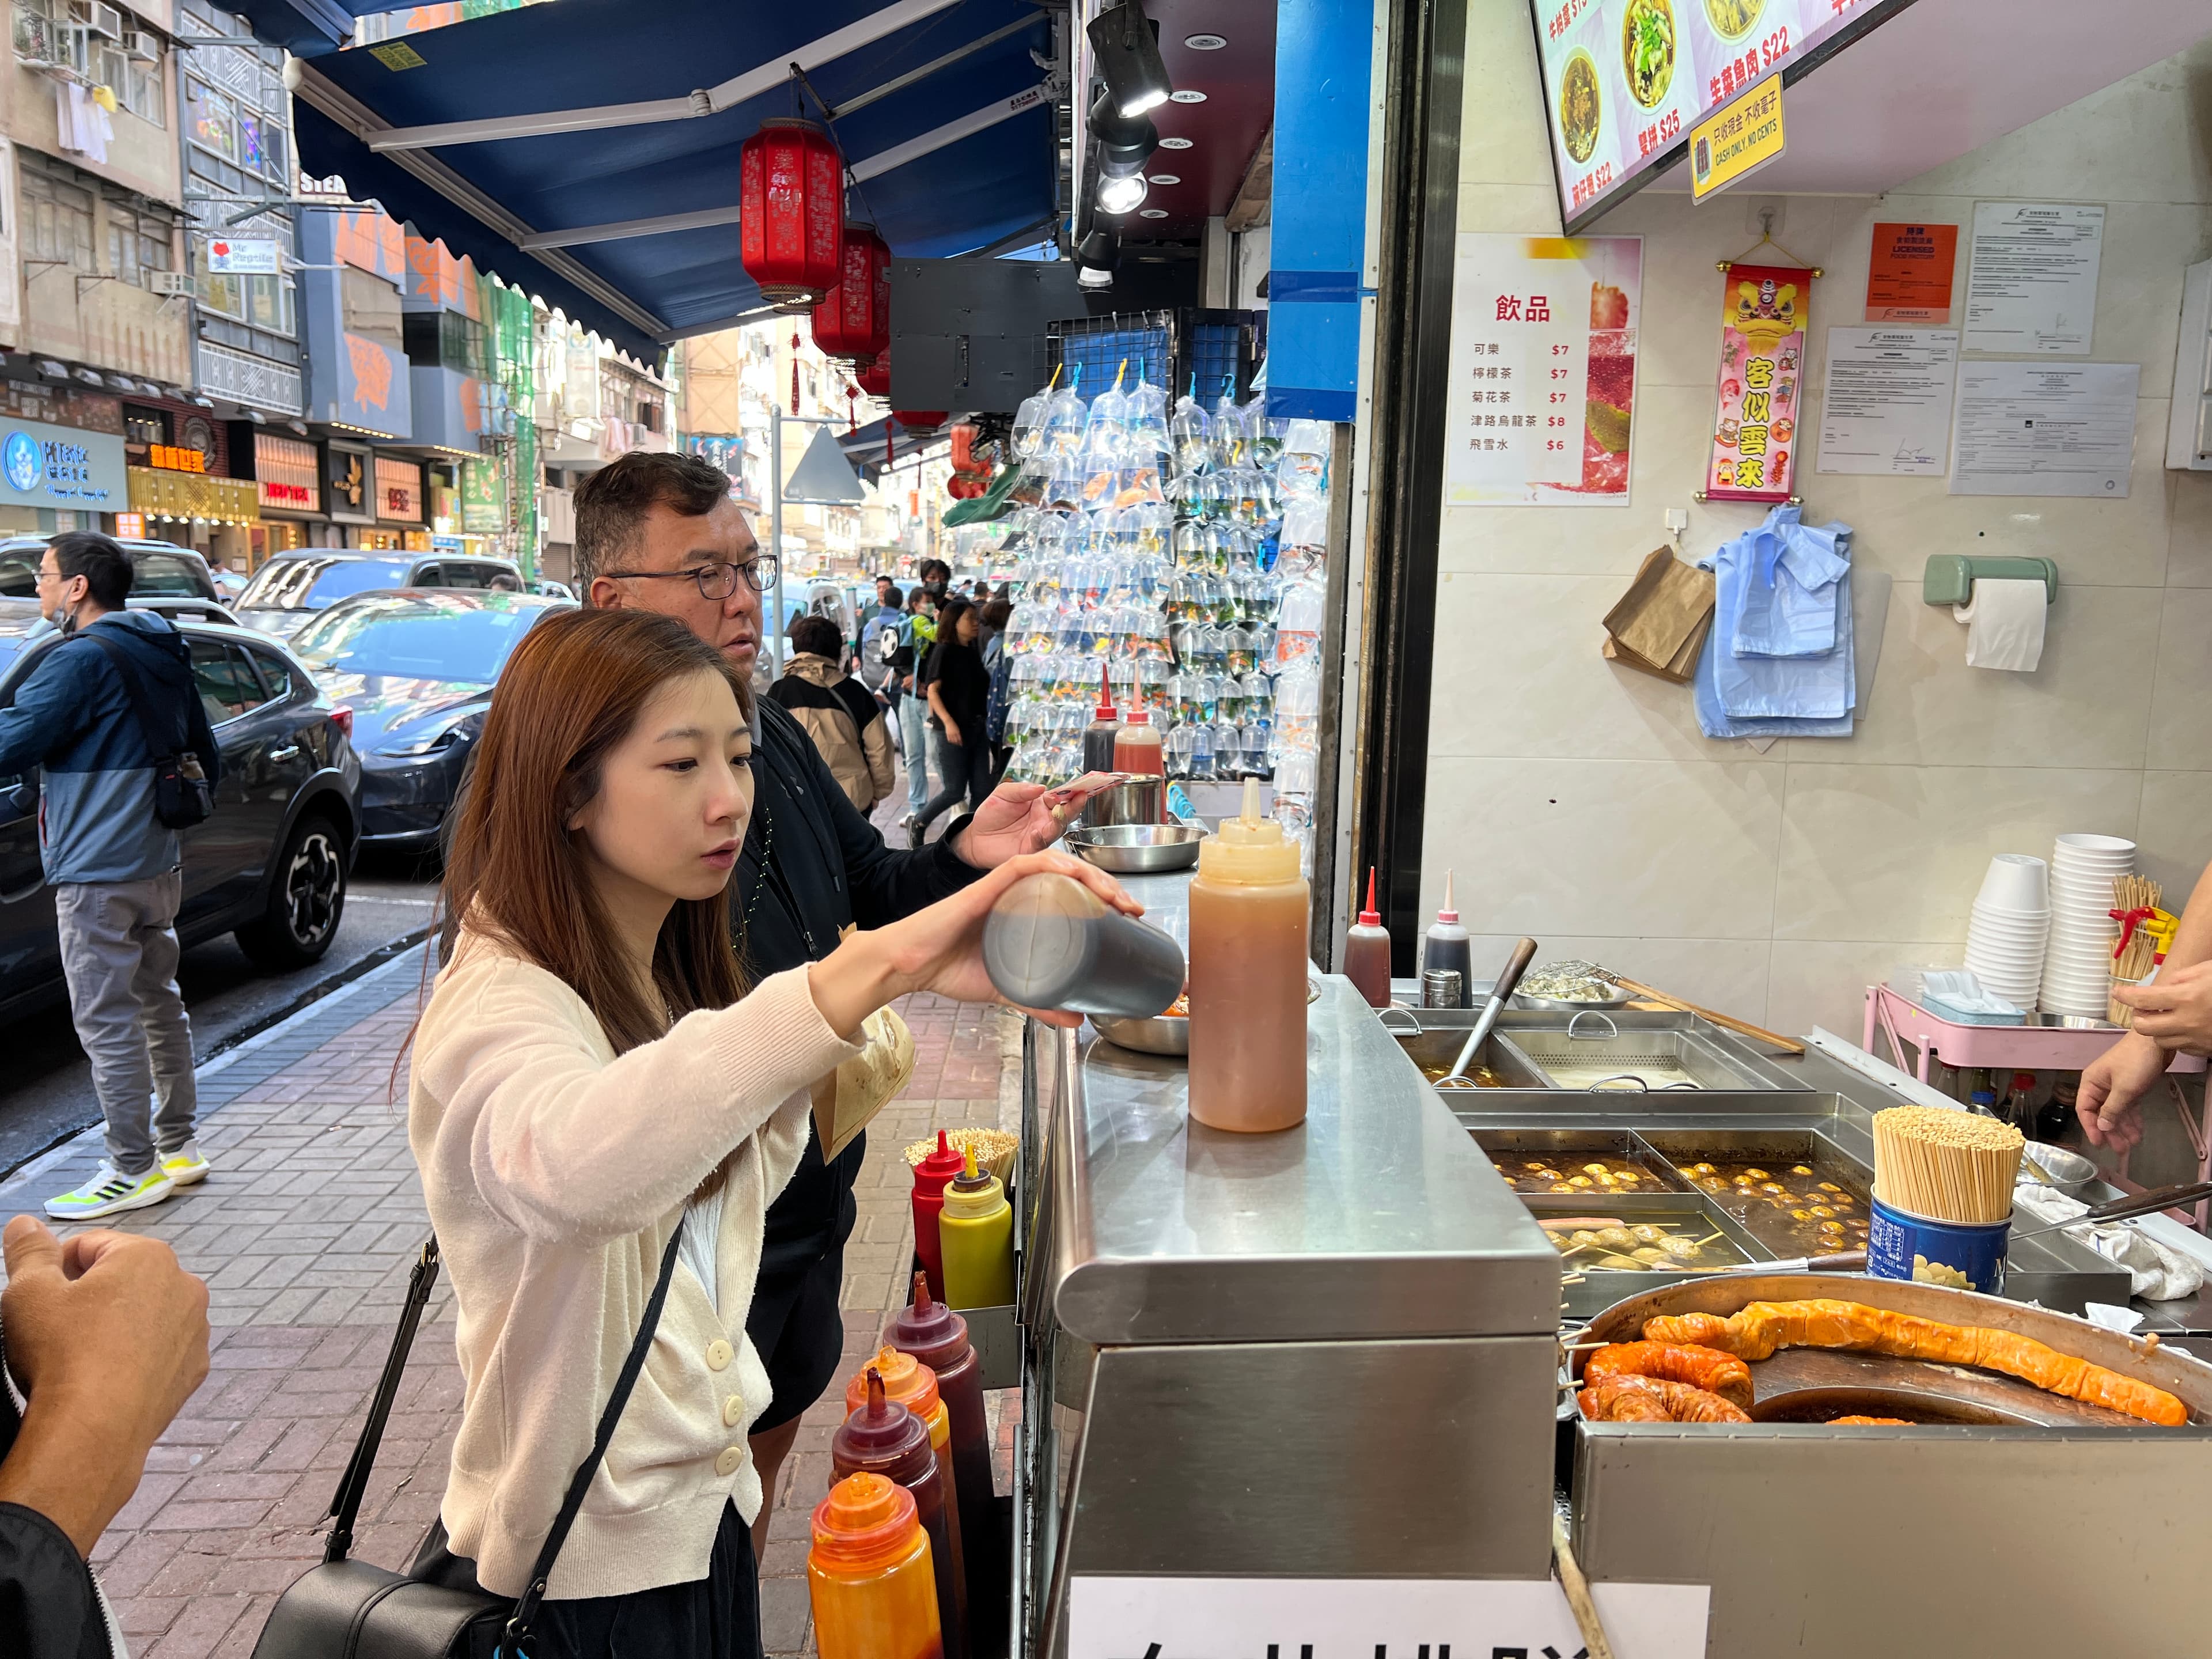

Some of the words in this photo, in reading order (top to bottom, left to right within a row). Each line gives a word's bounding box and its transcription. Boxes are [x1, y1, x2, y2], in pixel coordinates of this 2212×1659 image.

[1762, 25, 1790, 67] $22
[1660, 108, 1680, 142] $25
[1713, 113, 1743, 146] 只收現金
[1744, 90, 1777, 125] 不收毫子
[1715, 145, 1730, 166] CASH
[1732, 137, 1748, 157] ONLY,
[1748, 131, 1756, 147] NO
[1757, 118, 1777, 142] CENTS
[1596, 161, 1612, 190] $22
[232, 243, 247, 252] Mr
[232, 252, 273, 263] Reptile
[1495, 294, 1551, 323] 飲品
[1474, 343, 1499, 355] 可樂
[1552, 344, 1569, 357] $7
[1472, 367, 1512, 380] 檸檬茶
[1551, 368, 1568, 380] $7
[1472, 391, 1511, 403] 菊花茶
[1550, 392, 1567, 404] $7
[1548, 415, 1566, 428] $8
[1735, 357, 1775, 488] 客似雲來
[1469, 438, 1509, 451] 飛雪水
[1547, 439, 1564, 452] $6
